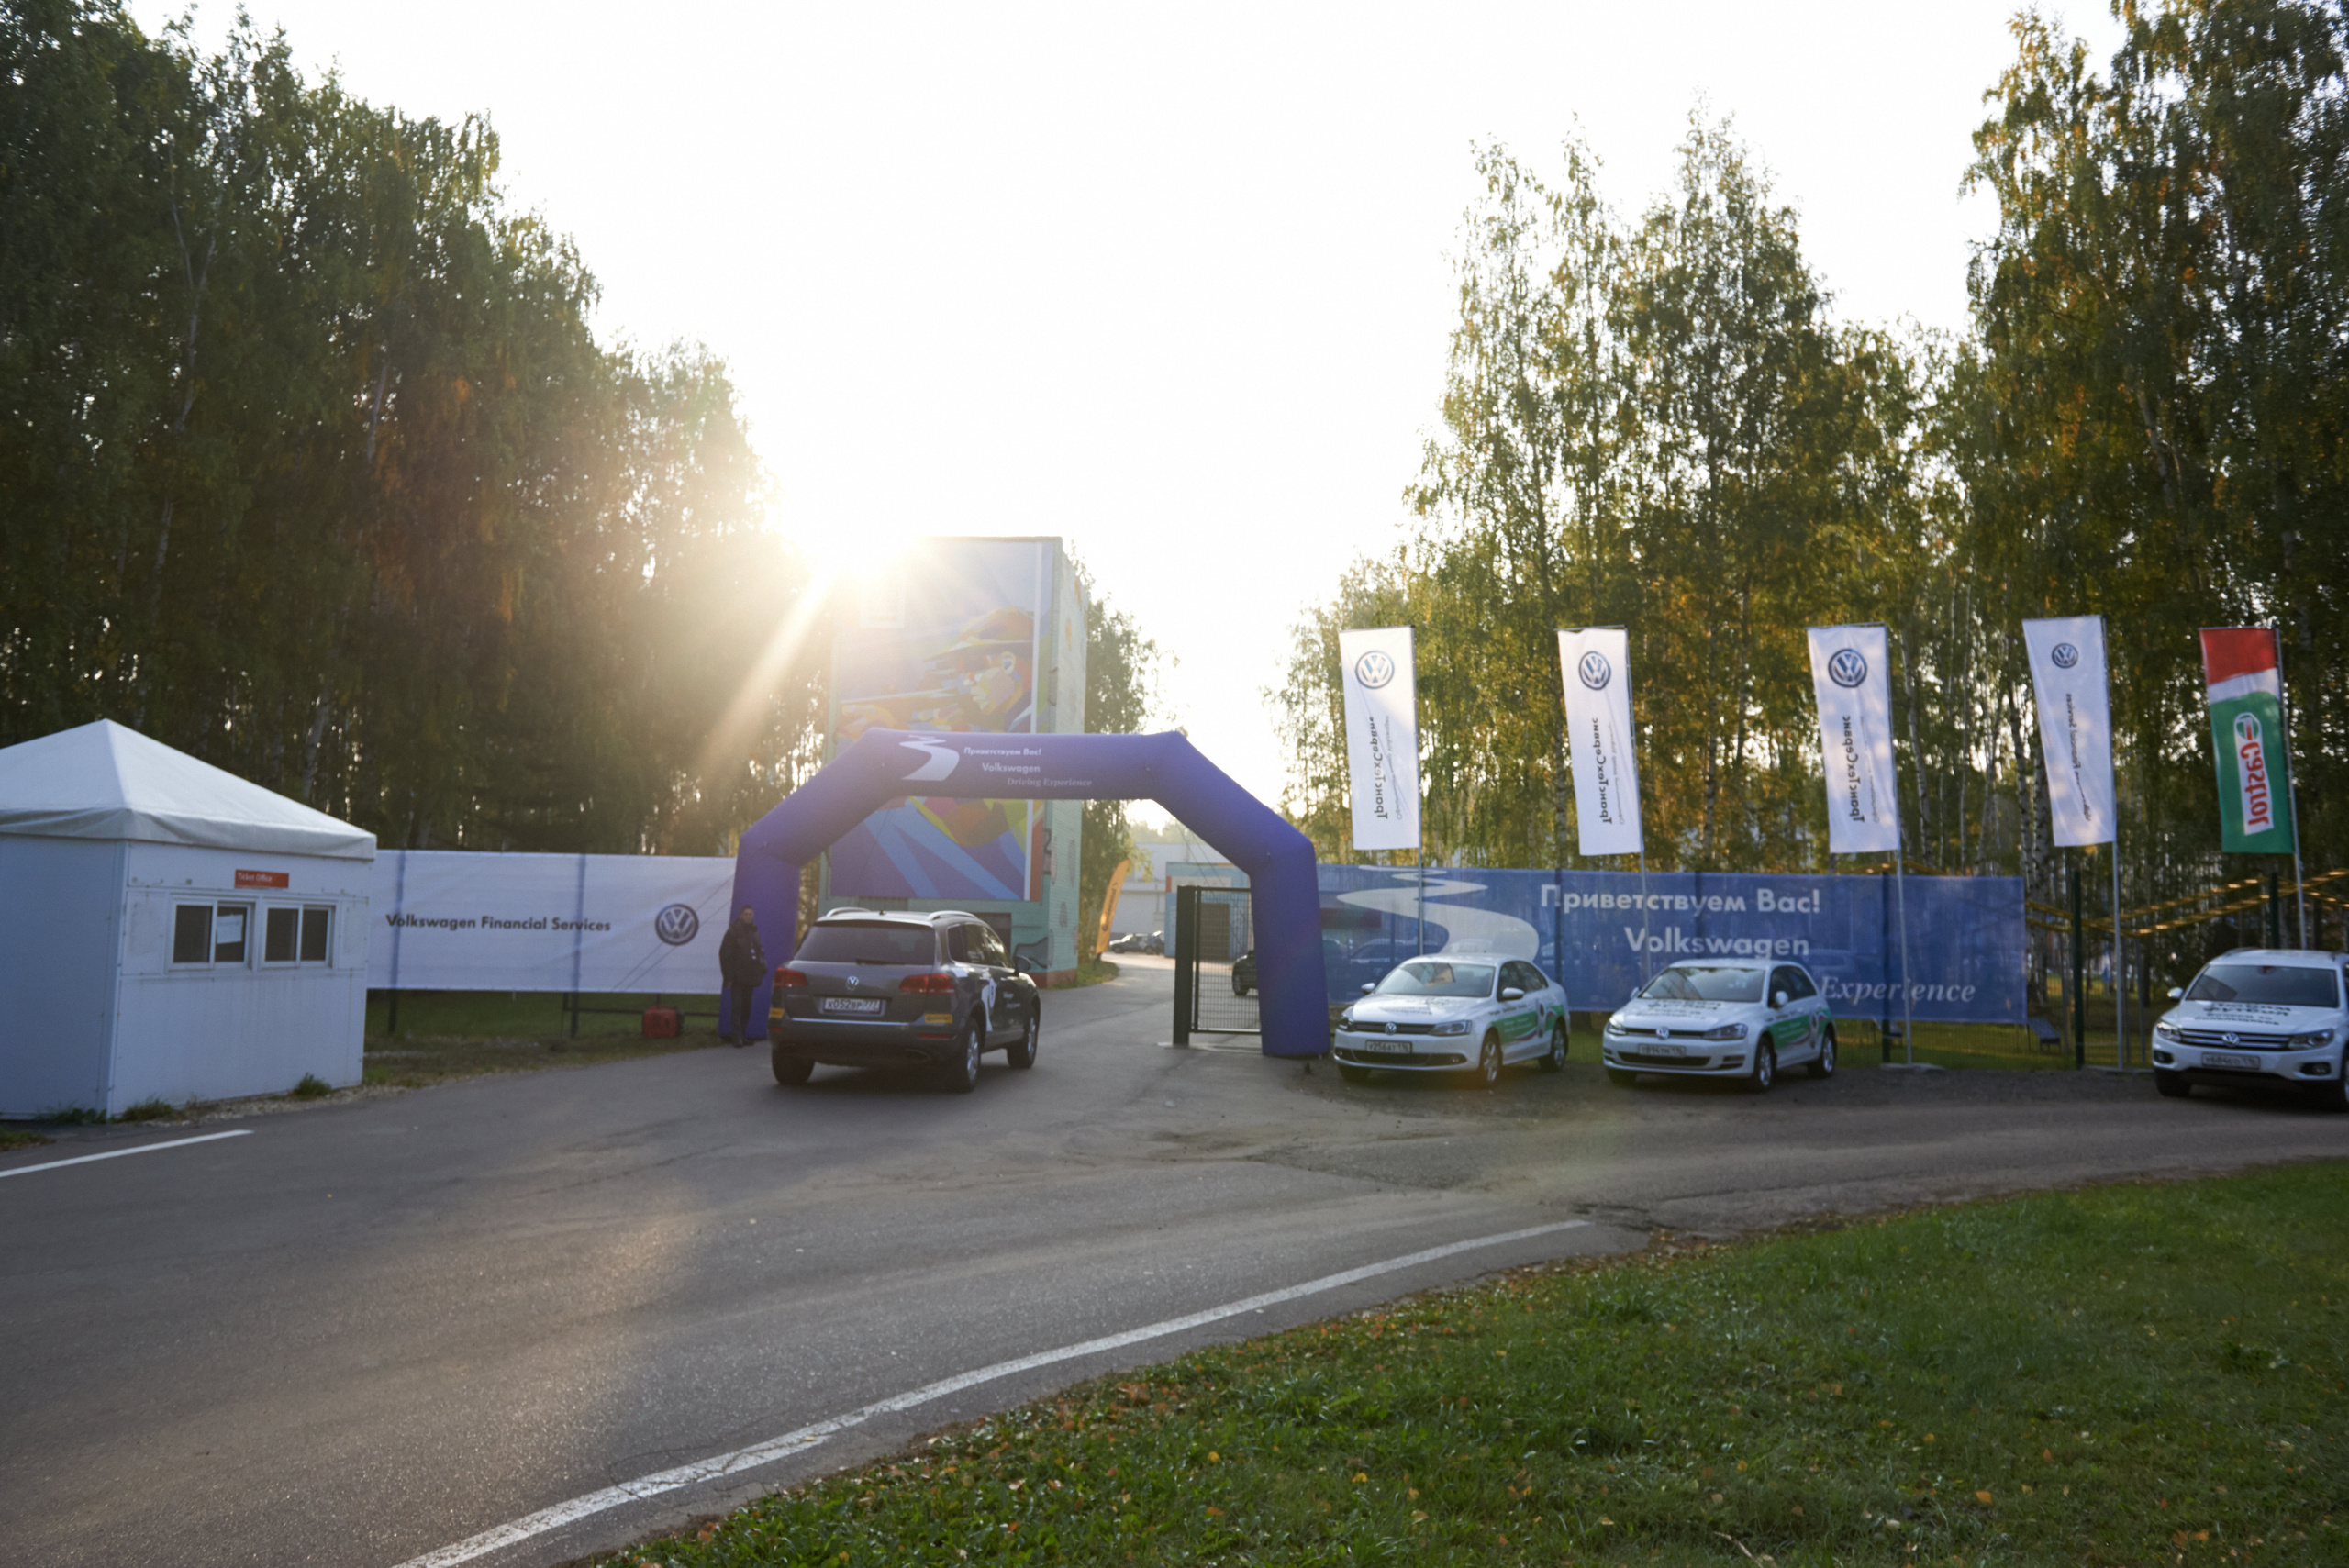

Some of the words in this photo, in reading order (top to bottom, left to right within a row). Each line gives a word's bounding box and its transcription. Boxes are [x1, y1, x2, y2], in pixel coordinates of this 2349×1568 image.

[963, 747, 1021, 757] Приветствуем
[1023, 748, 1042, 756] Вас!
[982, 762, 1041, 774] Volkswagen
[1007, 777, 1041, 787] Driving
[1043, 778, 1093, 787] Experience
[238, 873, 254, 881] Ticket
[256, 873, 273, 882] Office
[1541, 884, 1747, 916] Приветствуем
[1757, 888, 1820, 913] Вас!
[385, 915, 476, 931] Volkswagen
[481, 916, 547, 930] Financial
[551, 917, 611, 931] Services
[1624, 927, 1810, 958] Volkswagen
